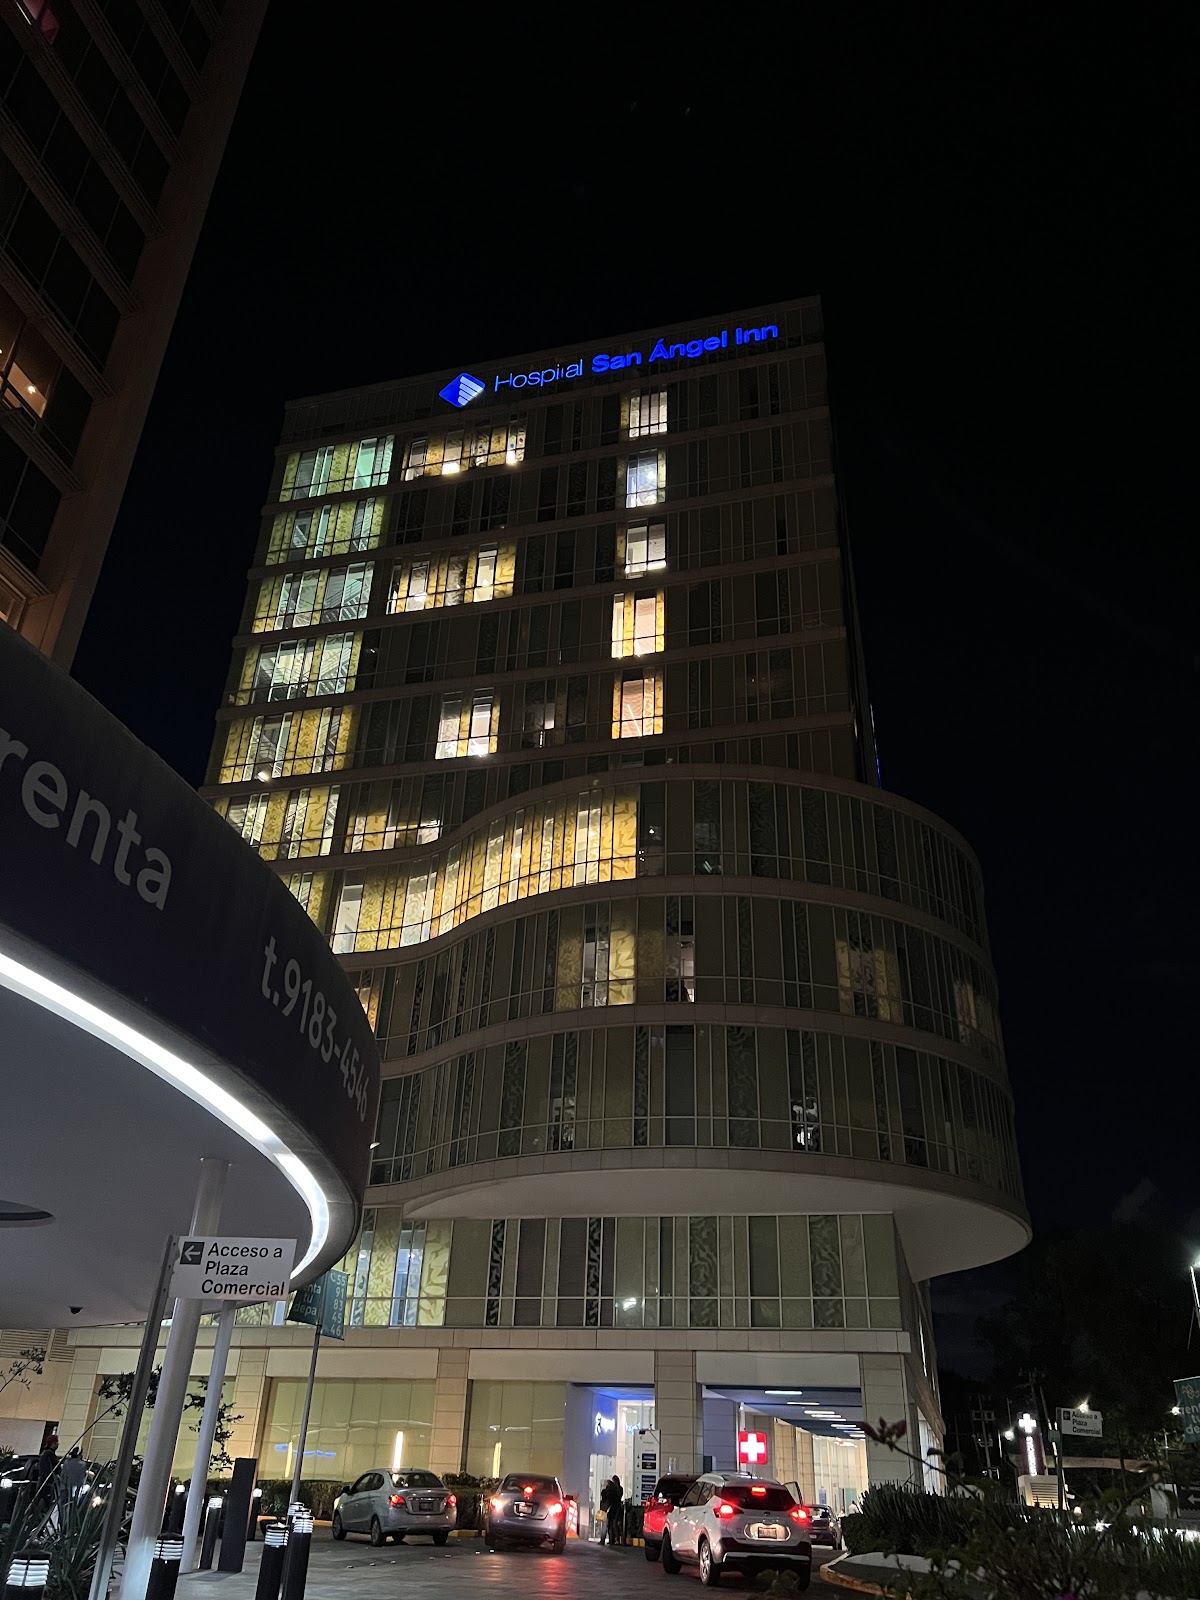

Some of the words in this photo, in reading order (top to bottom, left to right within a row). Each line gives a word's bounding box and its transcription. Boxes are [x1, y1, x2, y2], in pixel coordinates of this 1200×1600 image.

[591, 350, 642, 373] San
[648, 330, 729, 363] Ángel
[735, 324, 779, 346] Inn
[207, 1242, 269, 1258] Acceso
[273, 1247, 283, 1258] a
[204, 1261, 249, 1276] Plaza
[336, 1274, 346, 1286] 55
[201, 1279, 285, 1296] Comercial
[335, 1287, 344, 1300] 91
[302, 1293, 314, 1304] tu
[333, 1298, 343, 1311] 83
[293, 1301, 317, 1317] depa
[331, 1311, 343, 1324] 45
[330, 1324, 341, 1336] 46
[1072, 1426, 1101, 1435] Comercial
